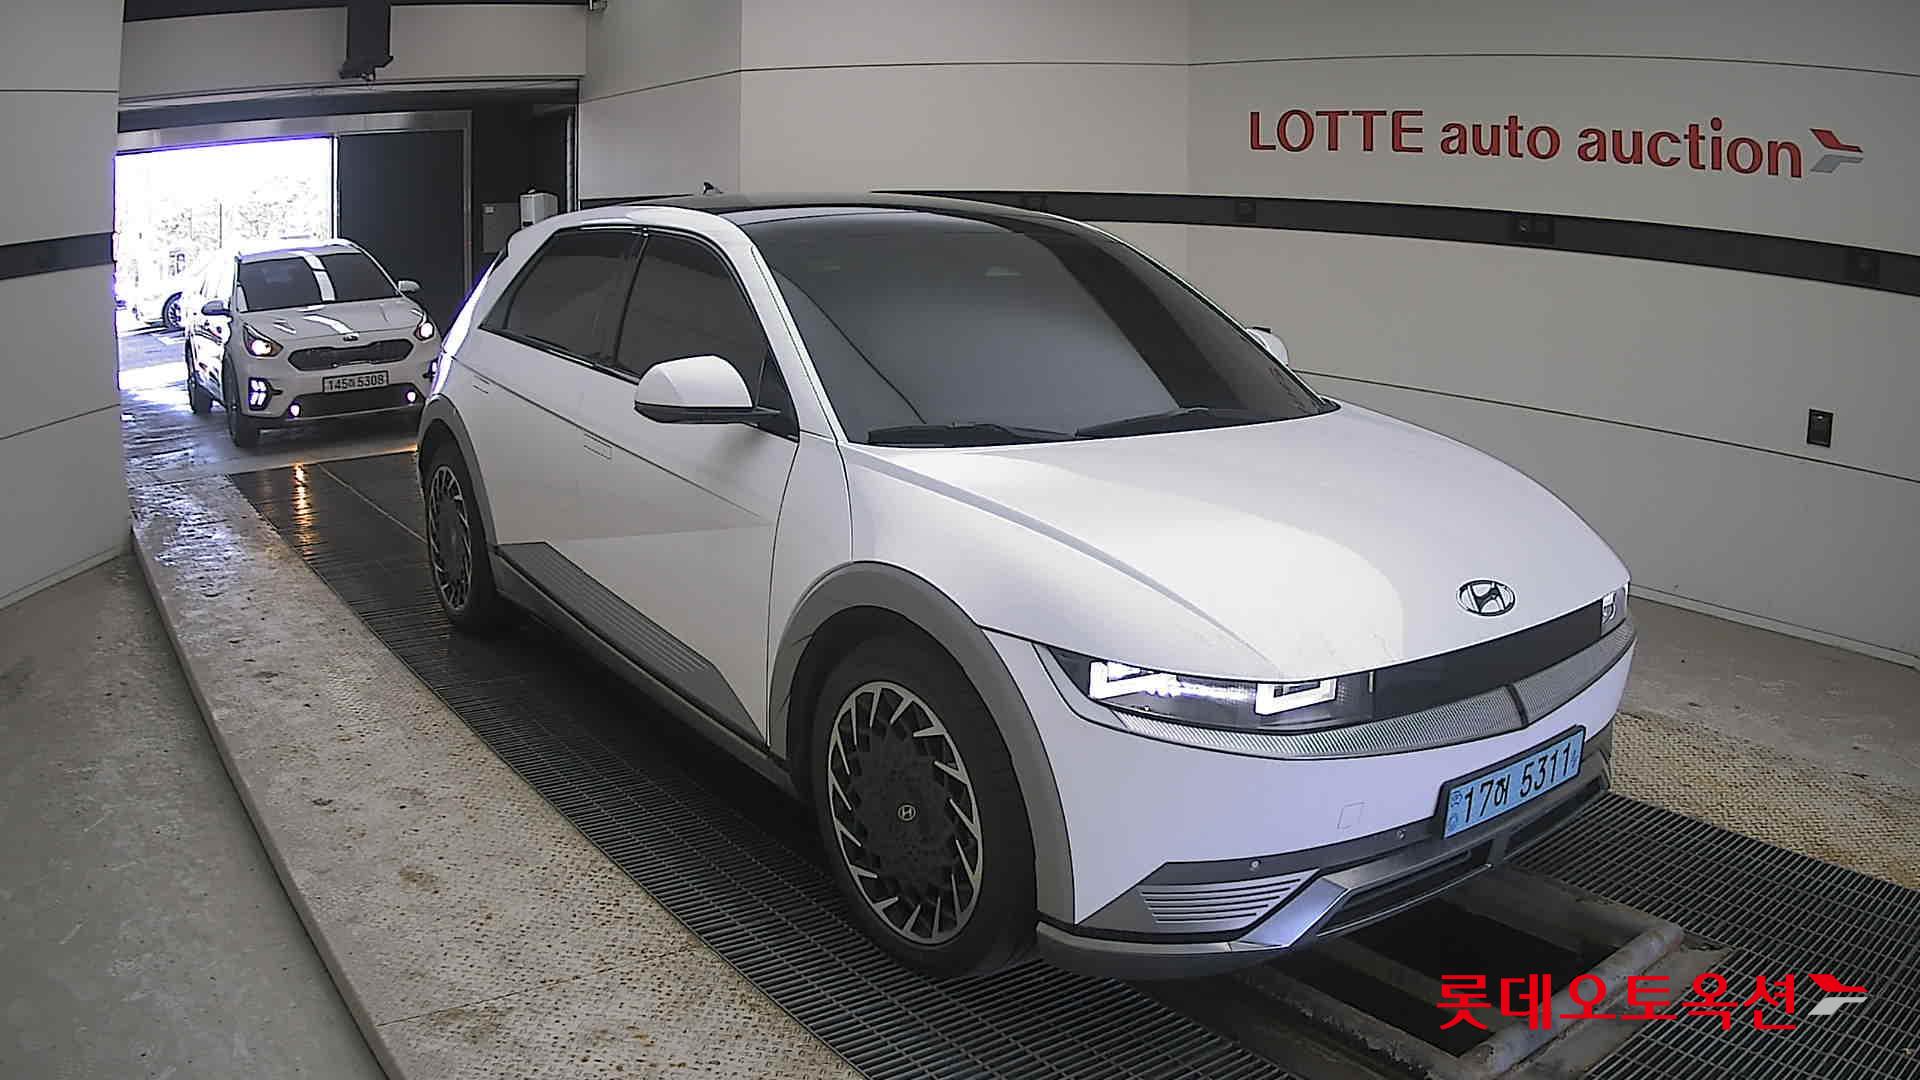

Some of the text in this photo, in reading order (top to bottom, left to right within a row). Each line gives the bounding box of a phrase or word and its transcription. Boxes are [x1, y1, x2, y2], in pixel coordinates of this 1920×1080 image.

[1249, 109, 1803, 178] LOTTE auto auction
[1519, 742, 1571, 798] 5311
